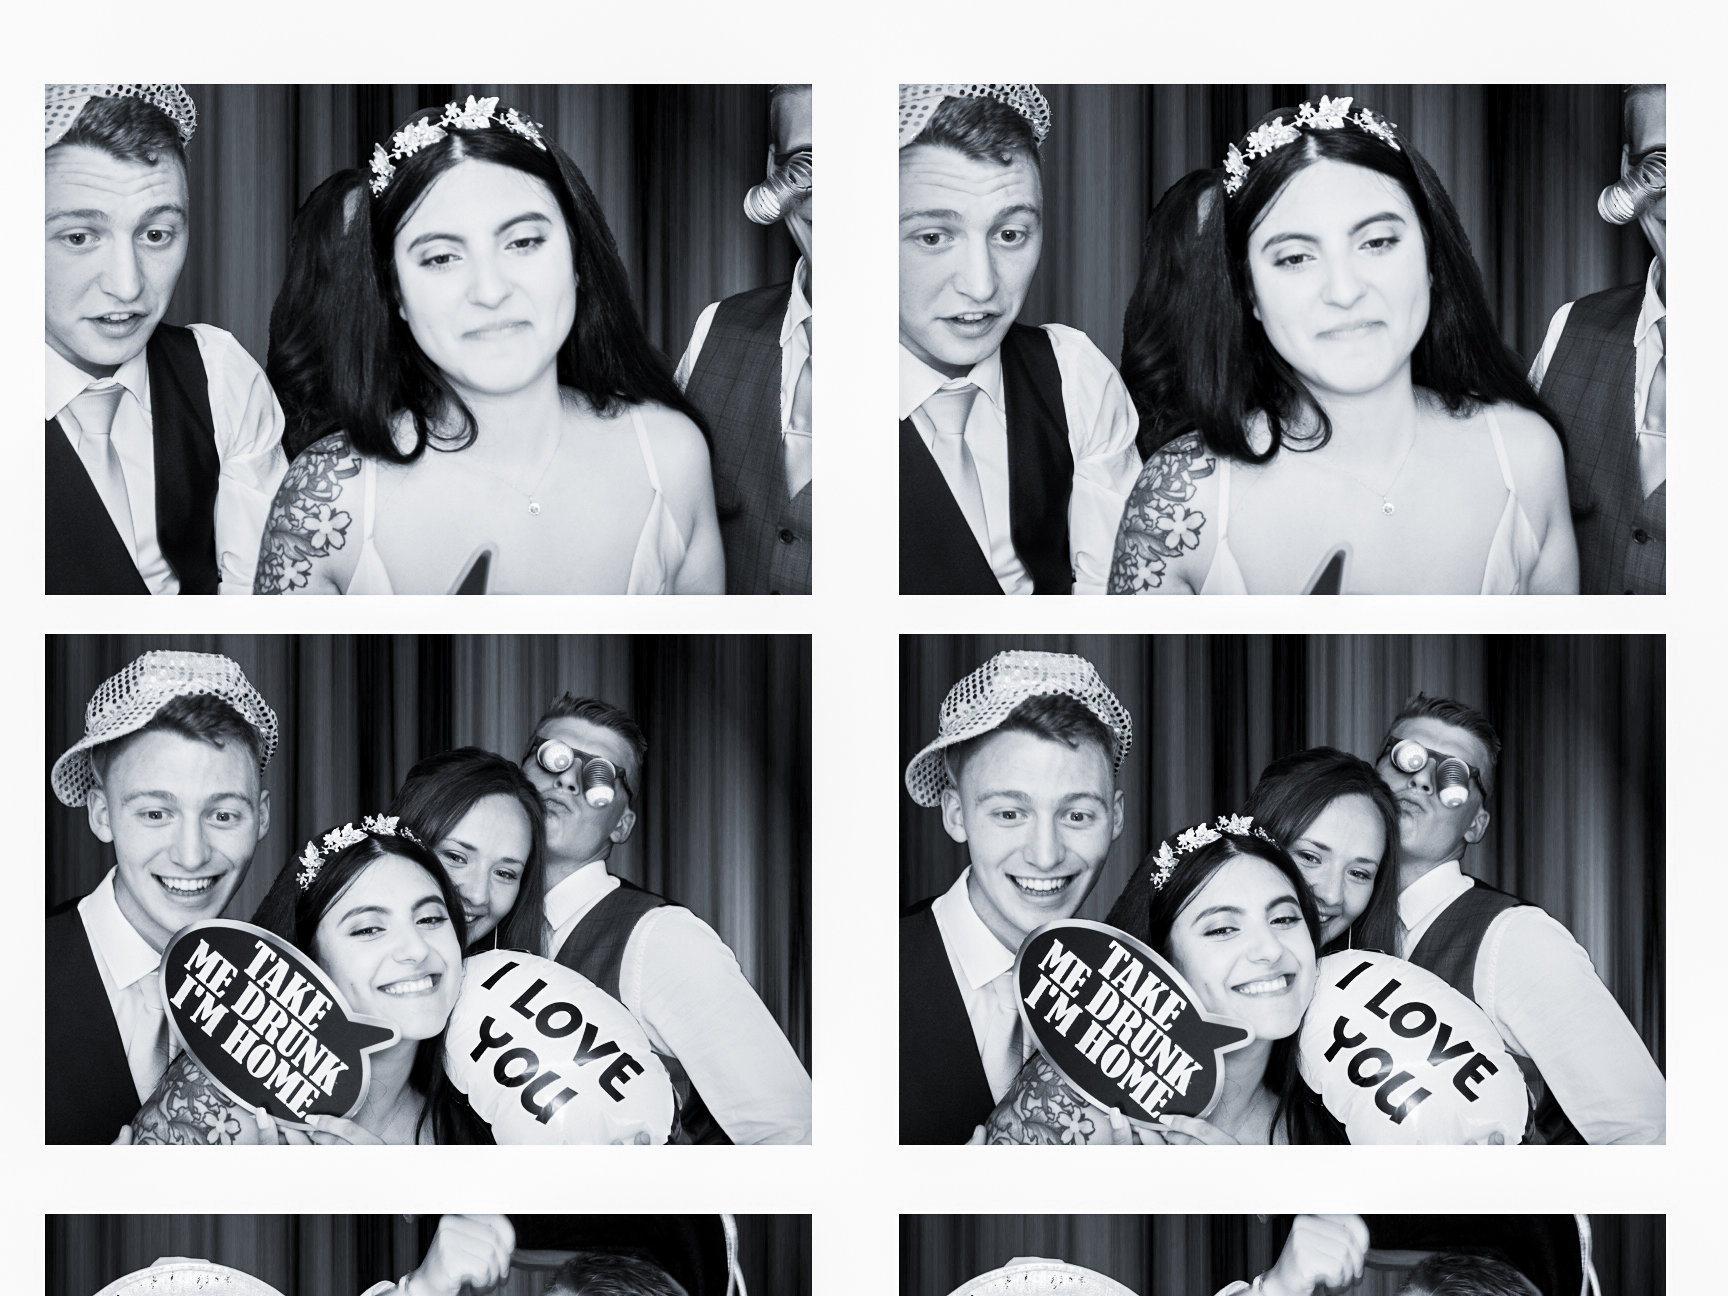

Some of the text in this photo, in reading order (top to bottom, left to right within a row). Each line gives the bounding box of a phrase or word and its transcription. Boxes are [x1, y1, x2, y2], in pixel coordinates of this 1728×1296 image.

[169, 973, 321, 1119] I'M HOME
[183, 938, 350, 1097] ME DRUNK
[243, 939, 333, 1032] TAKE
[481, 961, 645, 1103] I LOVE
[1023, 973, 1175, 1119] I'M HOME
[1037, 938, 1204, 1097] ME DRUNK
[1097, 939, 1187, 1032] TAKE
[1335, 961, 1499, 1103] I LOVE
[469, 1015, 579, 1125] YOU
[1323, 1015, 1433, 1125] YOU
